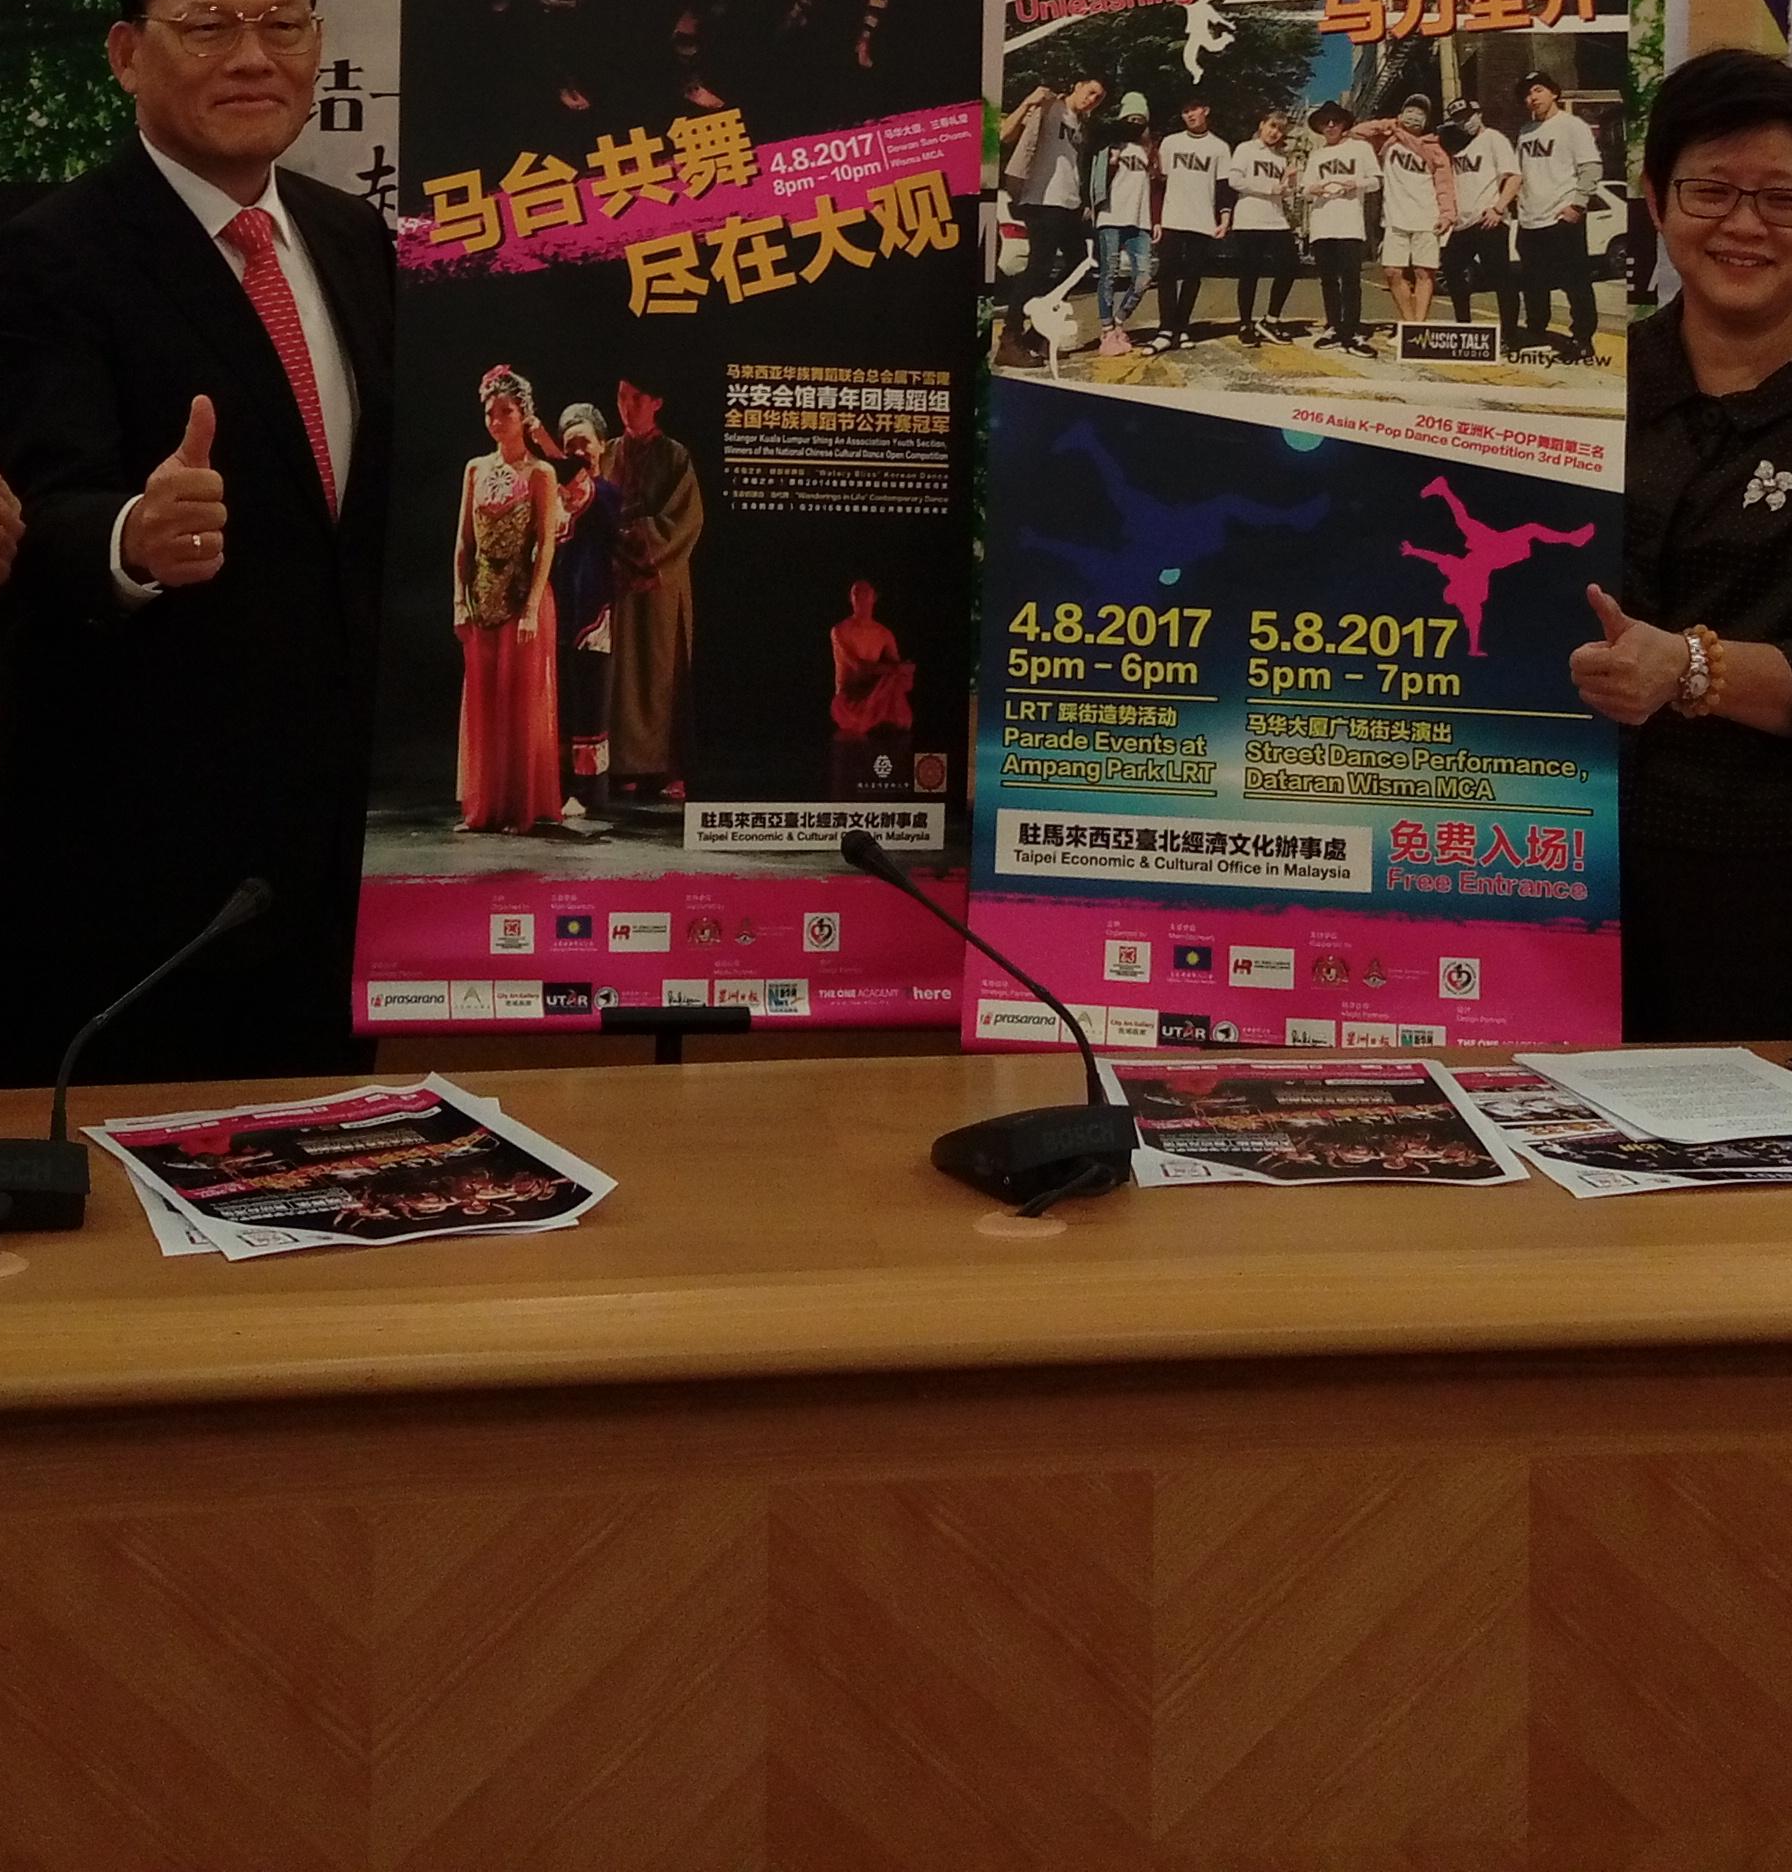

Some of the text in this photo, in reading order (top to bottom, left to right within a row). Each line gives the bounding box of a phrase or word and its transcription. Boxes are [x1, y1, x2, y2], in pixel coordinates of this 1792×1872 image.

[770, 133, 874, 175] 4.8.2017
[423, 108, 760, 255] 马台共舞
[773, 162, 883, 197] 8pm 10pm
[626, 169, 961, 319] 尽在大观
[1460, 334, 1491, 351] TALK
[1507, 349, 1555, 370] Unity
[725, 383, 951, 414] 兴安会馆青年团舞蹈组
[1414, 414, 1454, 433] 2016
[1291, 408, 1604, 473] 2016 Asia K-Pop Dance Competition 3rd Place
[1008, 601, 1213, 648] 4.8.2017
[1248, 609, 1459, 659] 5.8.2017
[1008, 647, 1199, 690] 5pm 6pm
[1246, 657, 1461, 701] 5pm 7pm
[1004, 699, 1179, 728] LRT 踩街造势活动
[1246, 713, 1453, 745] 马华大厦广场街头演出
[1002, 727, 1207, 757] Parade Events at
[1245, 741, 1409, 769] Street Dance
[1001, 754, 1217, 784] Ampang Park LRT
[1244, 768, 1496, 801] Dataran Wisma MCA
[697, 831, 931, 845] Taipei Economic Cultural Malaysia
[1388, 819, 1586, 873] 免费入场!
[1013, 849, 1352, 881] Taipei Economic Cultural Office in Malaysia
[1385, 868, 1589, 902] Free Entrance
[912, 986, 952, 1001] here
